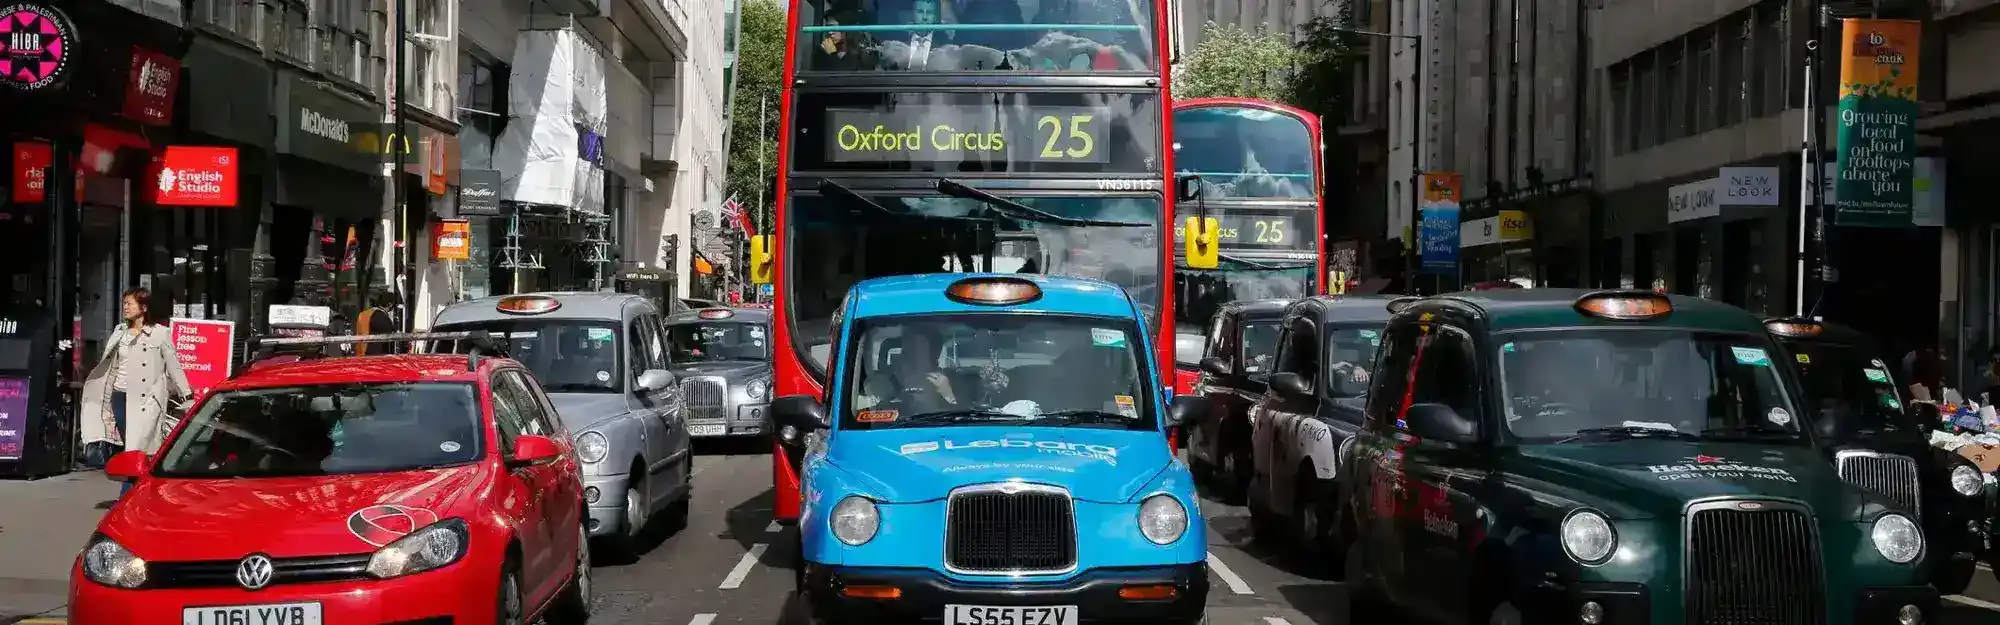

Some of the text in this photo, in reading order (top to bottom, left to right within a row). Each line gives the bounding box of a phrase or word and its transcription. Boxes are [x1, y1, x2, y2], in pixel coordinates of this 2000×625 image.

[30, 75, 53, 92] FOOD
[301, 107, 349, 143] McDonald's
[1842, 108, 1909, 127] growing
[837, 124, 1004, 151] Oxford Circus
[1037, 115, 1094, 158] 25
[1861, 122, 1897, 139] local
[1851, 145, 1870, 158] on
[1871, 138, 1904, 153] food
[1849, 155, 1911, 174] rooftops
[178, 169, 223, 184] English
[1731, 175, 1769, 186] NEW
[1842, 166, 1890, 181] above
[178, 181, 221, 193] Studio
[1728, 187, 1773, 198] LOOK
[1872, 181, 1900, 196] you
[1254, 220, 1284, 244] 25
[178, 324, 198, 335] First
[176, 341, 196, 351] free
[177, 333, 207, 344] lesson
[944, 437, 1117, 457] Lebara
[1646, 463, 1791, 476] Heineken
[1659, 471, 1703, 481] open
[1706, 470, 1745, 479] your
[953, 606, 1016, 625] LS55
